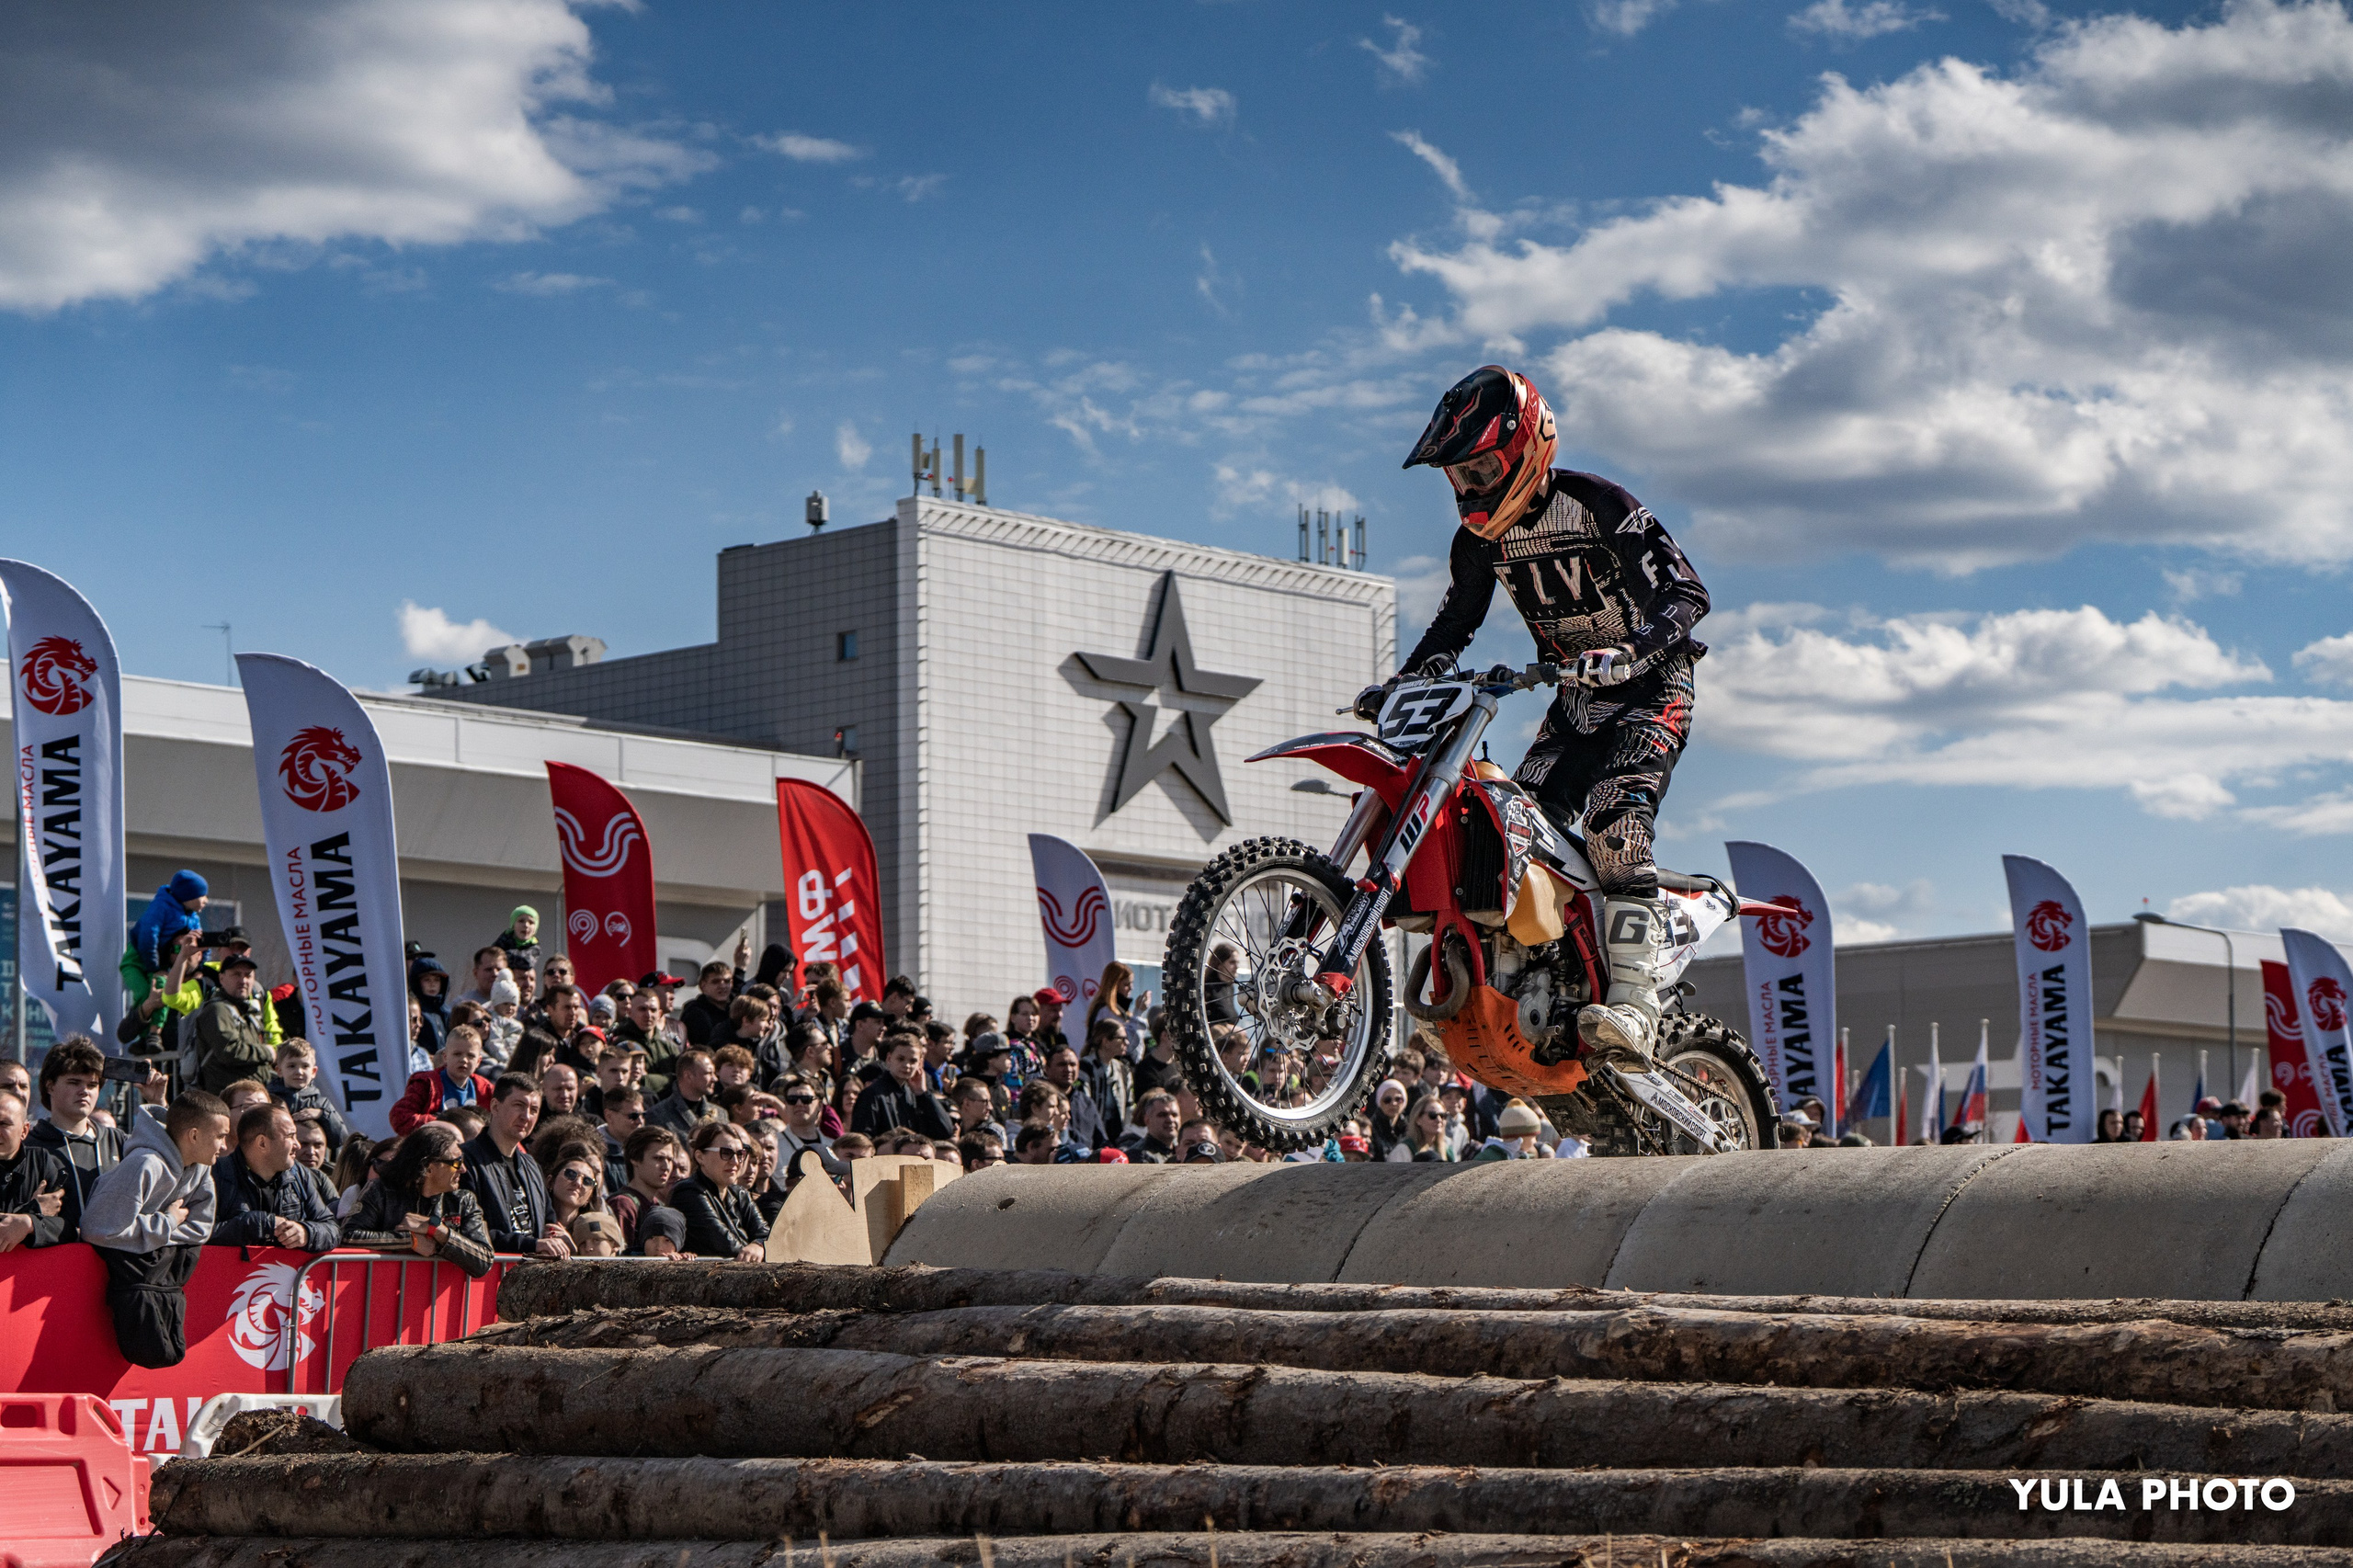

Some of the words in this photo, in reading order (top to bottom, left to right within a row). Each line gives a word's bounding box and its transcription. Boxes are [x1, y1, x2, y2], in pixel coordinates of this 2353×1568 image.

[1382, 687, 1461, 739] 53
[21, 744, 35, 810] МАСЛА
[1400, 793, 1429, 856] WP
[41, 733, 82, 992] TAKAYAMA
[287, 846, 309, 918] МАСЛА
[1350, 908, 1381, 957] МОСКОВСКИЙ
[1608, 910, 1650, 944] G
[310, 831, 382, 1112] TAKAYAMA
[2028, 972, 2040, 1017] МАСЛА
[1761, 981, 1776, 1033] МАСЛА
[1779, 971, 1816, 1107] AYAMA
[2029, 1019, 2041, 1091] МОТОРНЫЕ
[2042, 964, 2071, 1136] TAKAYAMA
